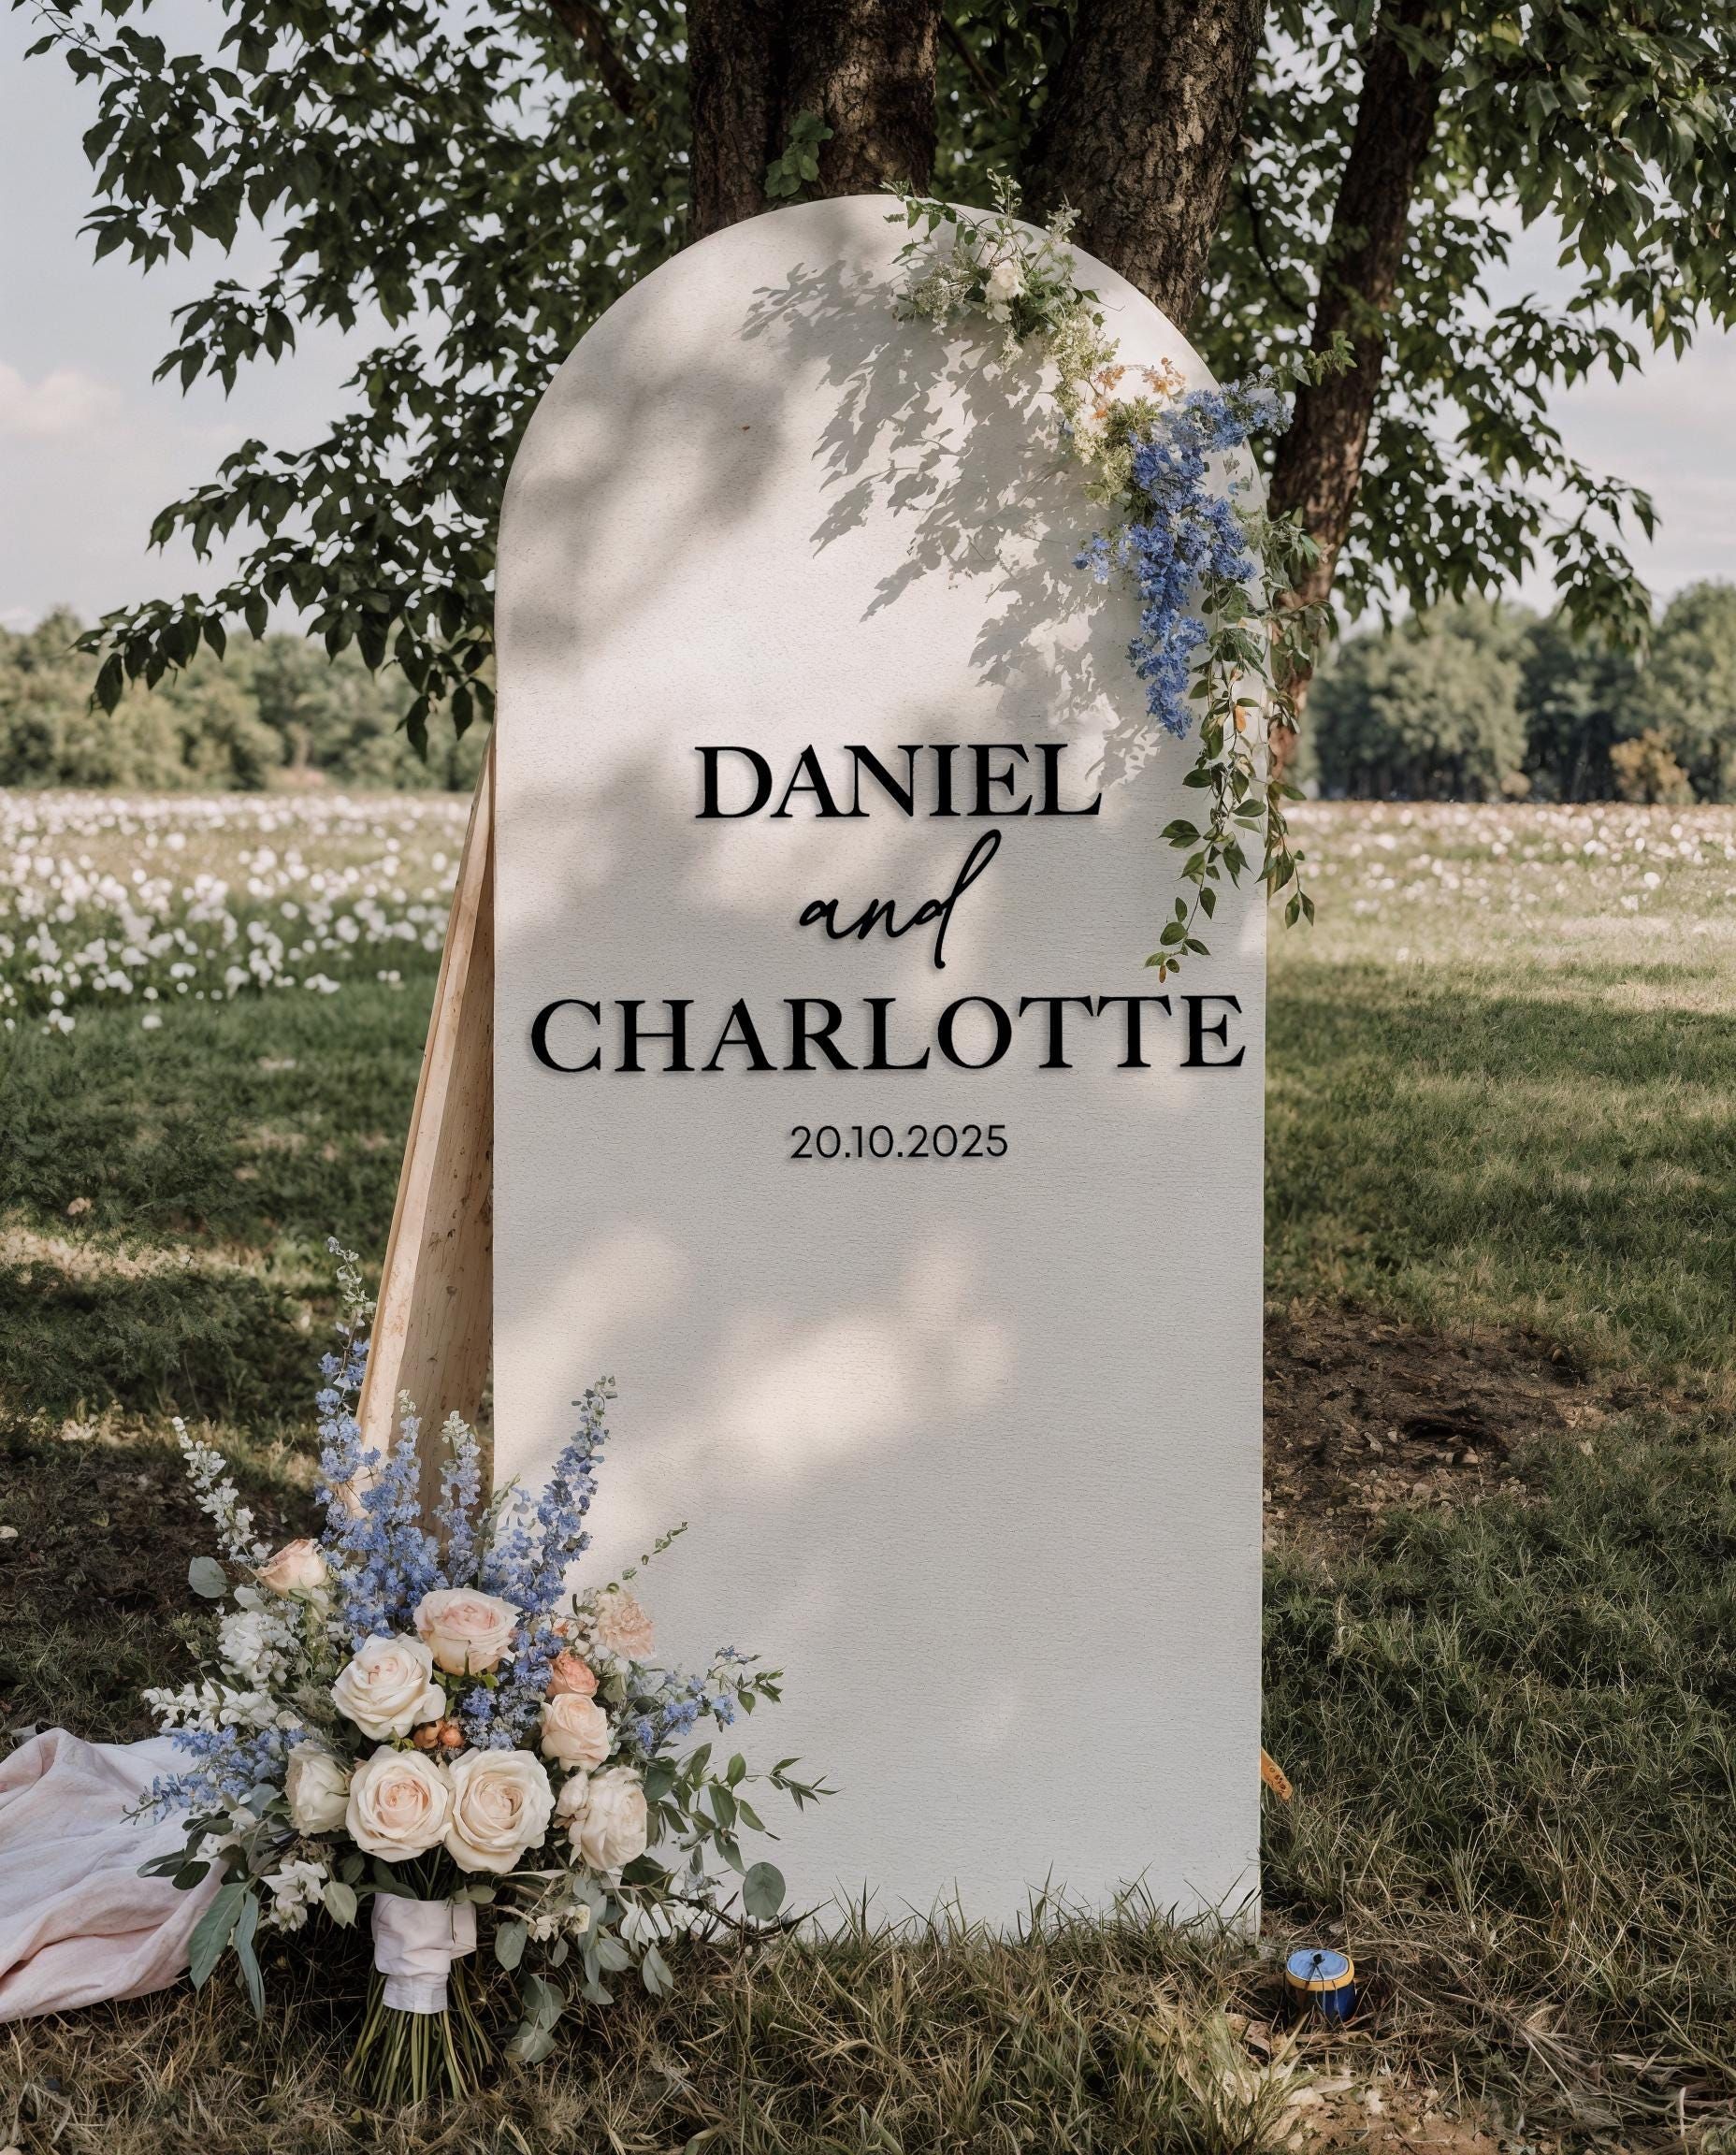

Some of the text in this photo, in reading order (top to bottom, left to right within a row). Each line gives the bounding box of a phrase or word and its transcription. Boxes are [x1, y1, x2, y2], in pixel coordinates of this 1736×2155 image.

[695, 744, 1102, 818] DANIEL
[799, 829, 1002, 970] and
[530, 995, 1246, 1073] CHARLOTTE
[790, 1124, 1008, 1159] 20.10.2025
